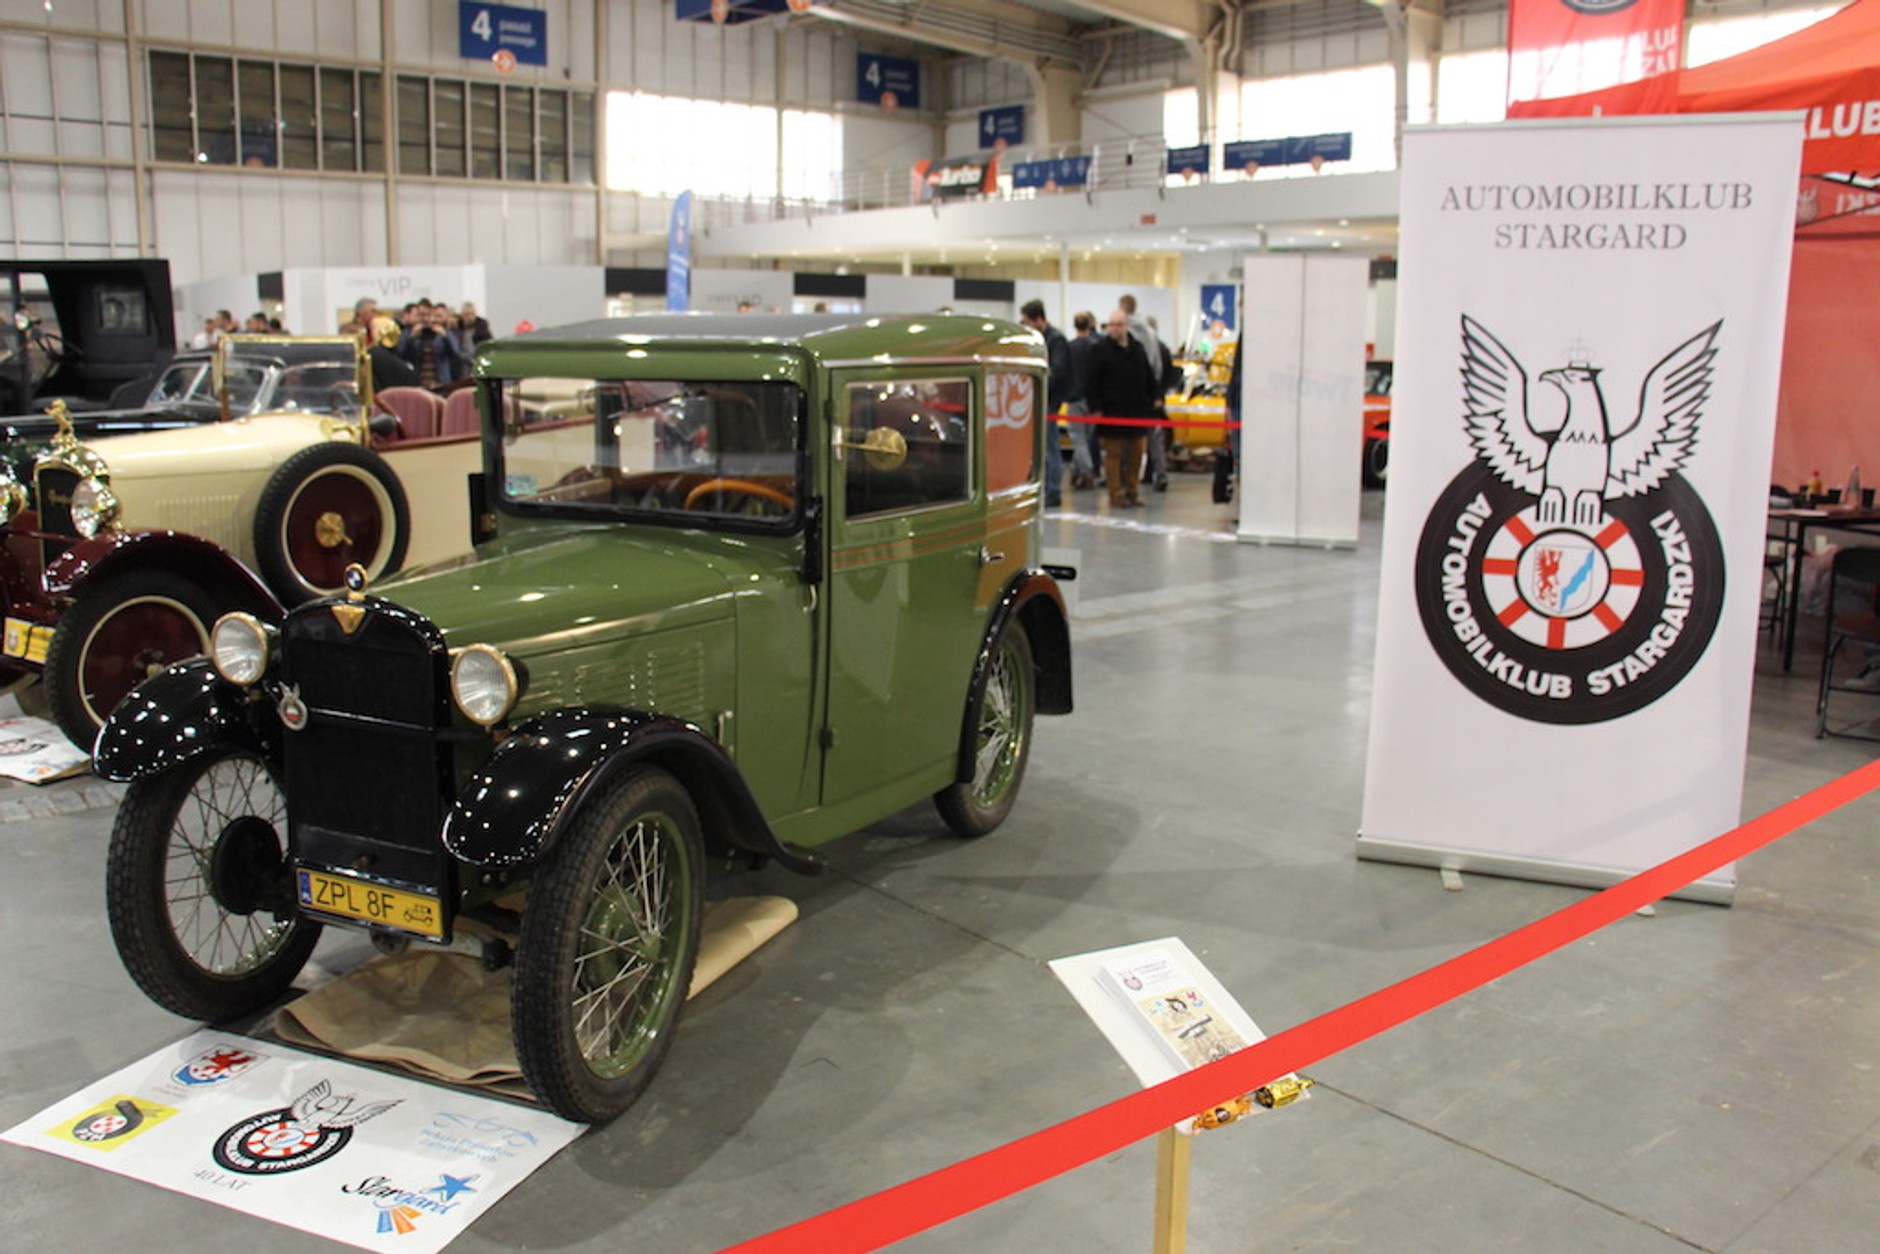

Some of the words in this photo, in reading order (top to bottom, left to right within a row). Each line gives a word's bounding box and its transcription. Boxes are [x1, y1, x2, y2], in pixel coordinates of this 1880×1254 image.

[471, 9, 492, 42] 4
[865, 61, 881, 88] 4
[984, 115, 996, 135] 4
[1801, 101, 1880, 140] LUB
[1440, 183, 1753, 212] AUTOMOBILKLUB
[1494, 223, 1687, 250] STARGARD
[377, 277, 411, 296] VIP
[1211, 293, 1225, 317] 4
[1442, 492, 1573, 699] AUTOMOBILKLUB
[1586, 510, 1695, 695] STARGARDZKI
[315, 878, 360, 912] ZPL
[367, 890, 395, 918] 8F
[341, 1175, 460, 1216] Stargard
